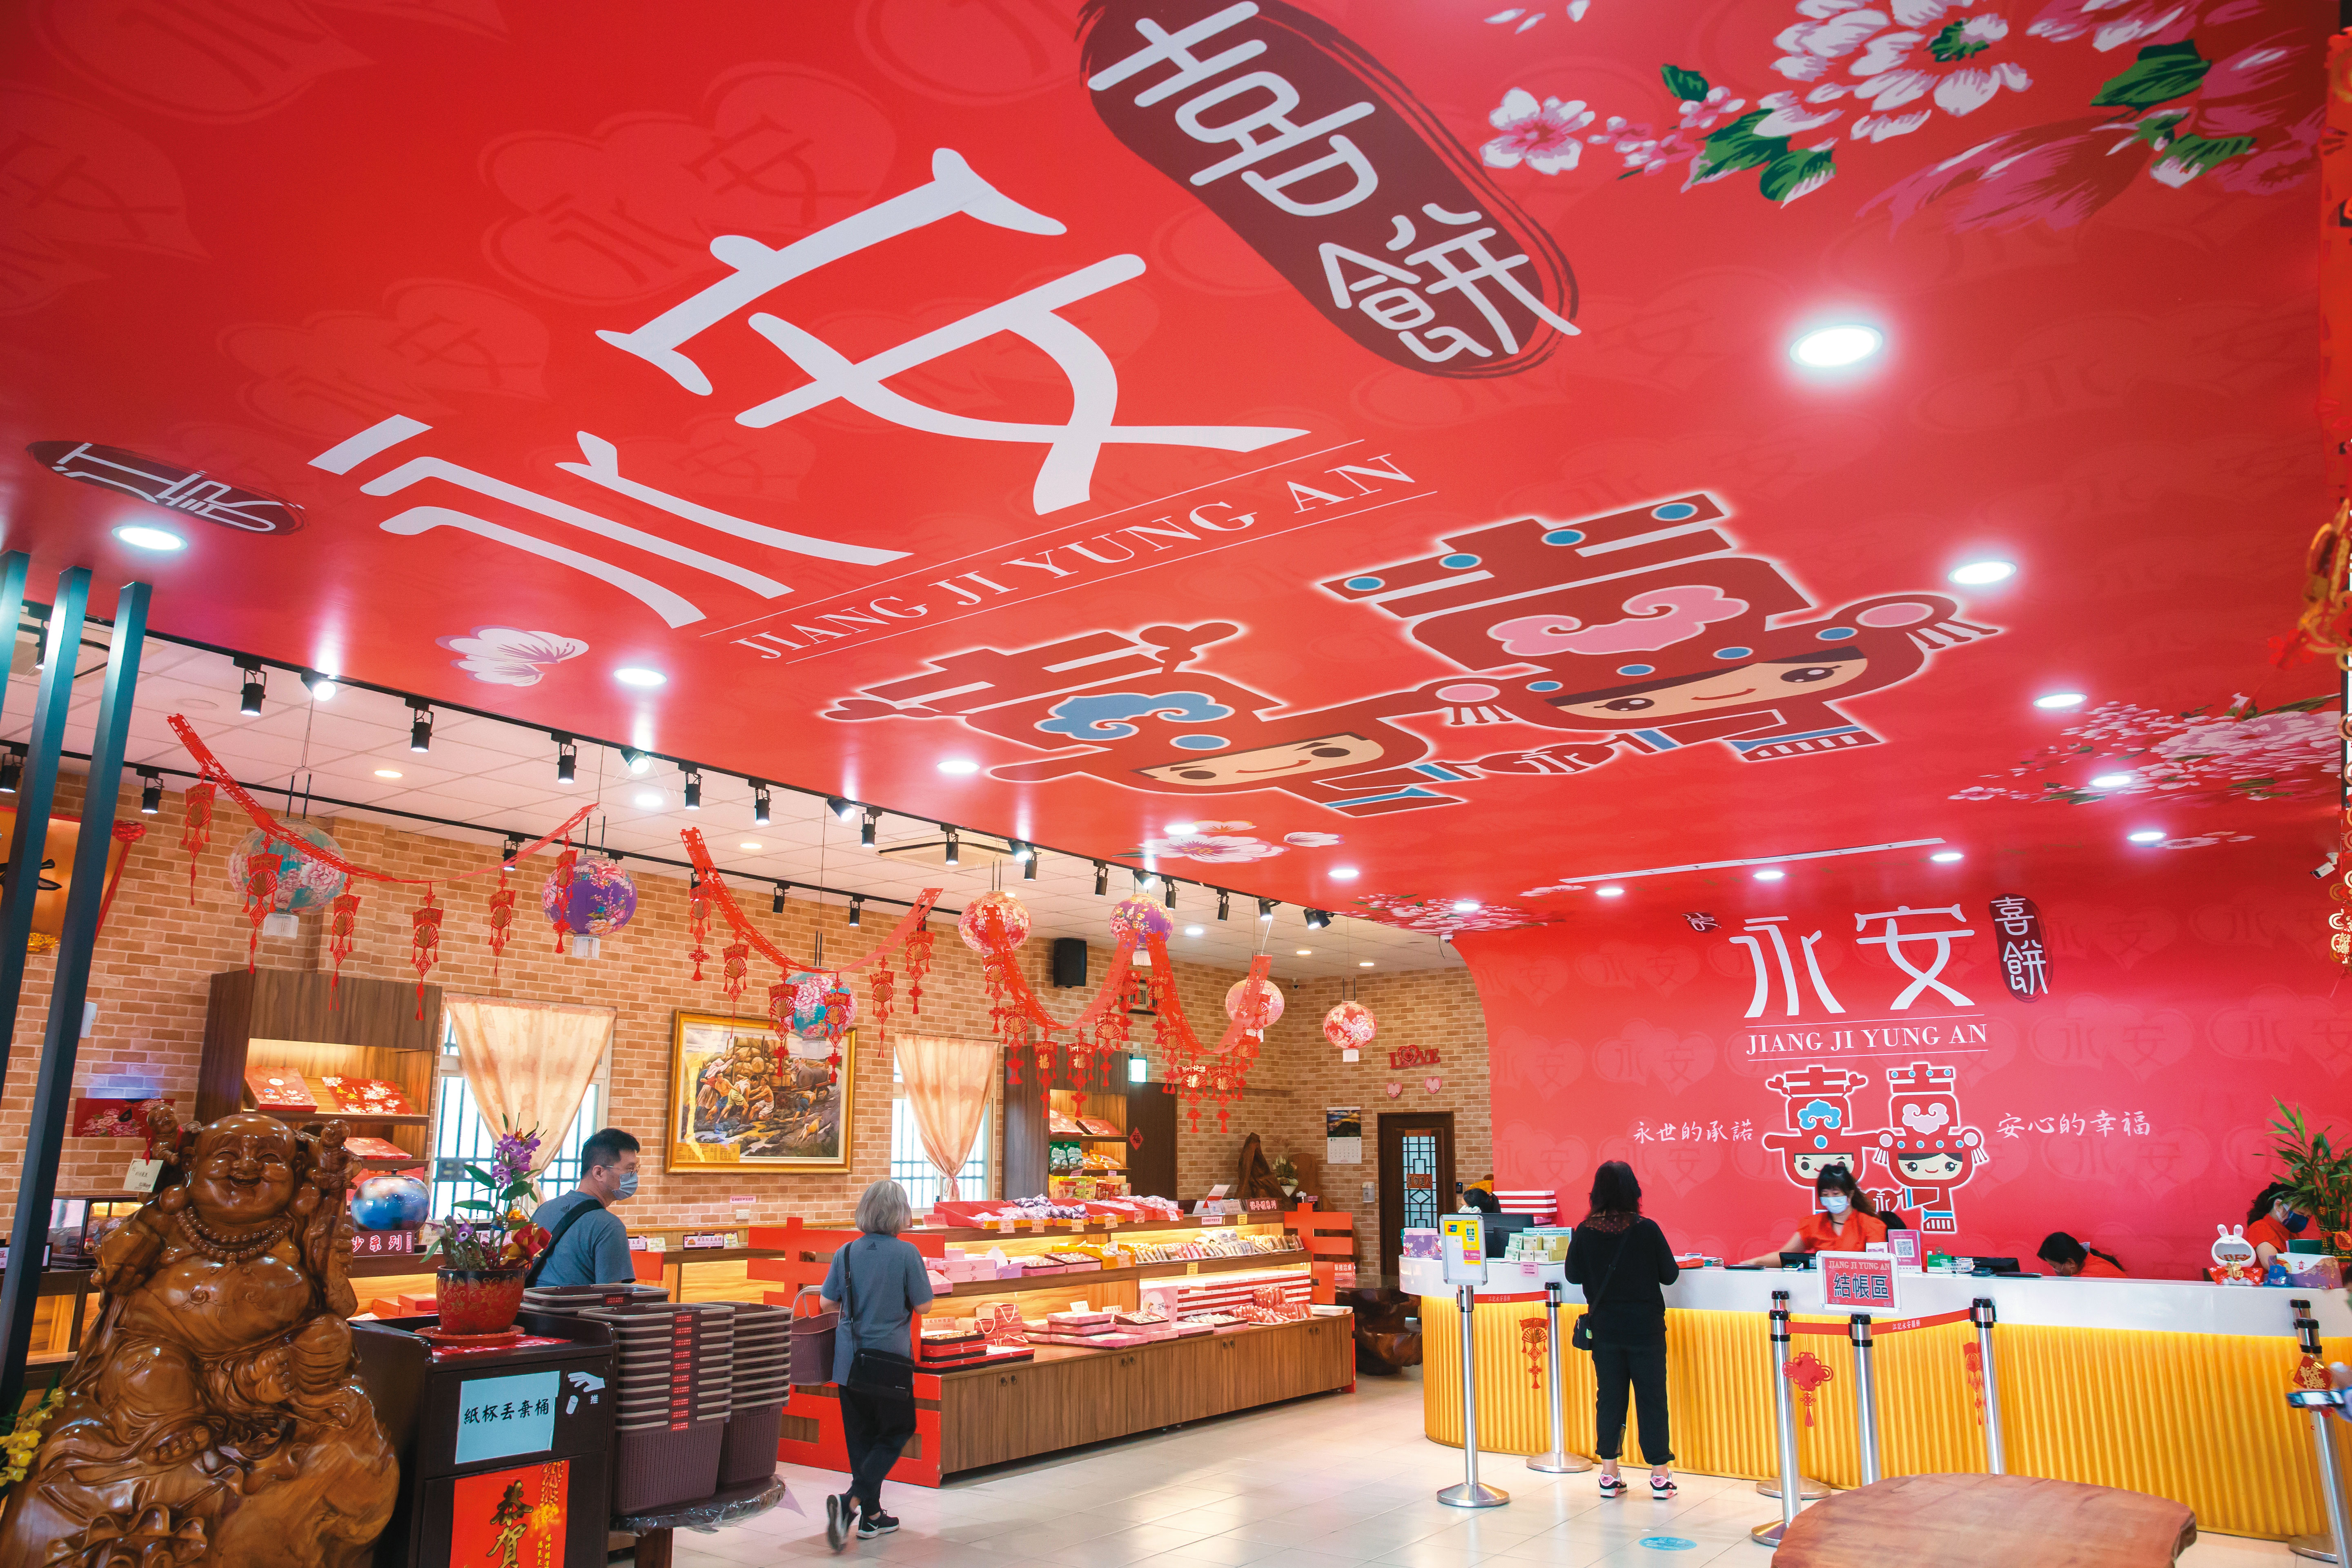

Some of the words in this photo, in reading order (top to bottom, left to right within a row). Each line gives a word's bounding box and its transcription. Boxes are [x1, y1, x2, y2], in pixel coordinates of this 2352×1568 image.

[1087, 1, 1581, 363] 喜餅
[730, 595, 928, 660] JIANG
[928, 570, 1019, 606] JI
[1000, 501, 1257, 580] YUNG
[1285, 454, 1416, 514] AN
[1729, 903, 1976, 1018] 永安
[1992, 896, 2049, 996] 喜餅
[1746, 1033, 1824, 1056] JIANG
[1831, 1031, 1855, 1051] JI
[1861, 1027, 1939, 1048] YUNG
[1949, 1024, 1988, 1044] AN
[1633, 1119, 1753, 1143] 永世的承諾
[1996, 1110, 2151, 1139] 安心的幸福
[1829, 1261, 1849, 1269] JIANG
[1851, 1261, 1858, 1270] JI
[1858, 1262, 1879, 1270] YUNG
[2225, 1261, 2245, 1278] 福
[1833, 1272, 1890, 1300] 結帳區
[463, 1398, 550, 1425] 紙杯丟棄桶
[590, 1394, 599, 1404] 推
[486, 1479, 534, 1568] 恭賀
